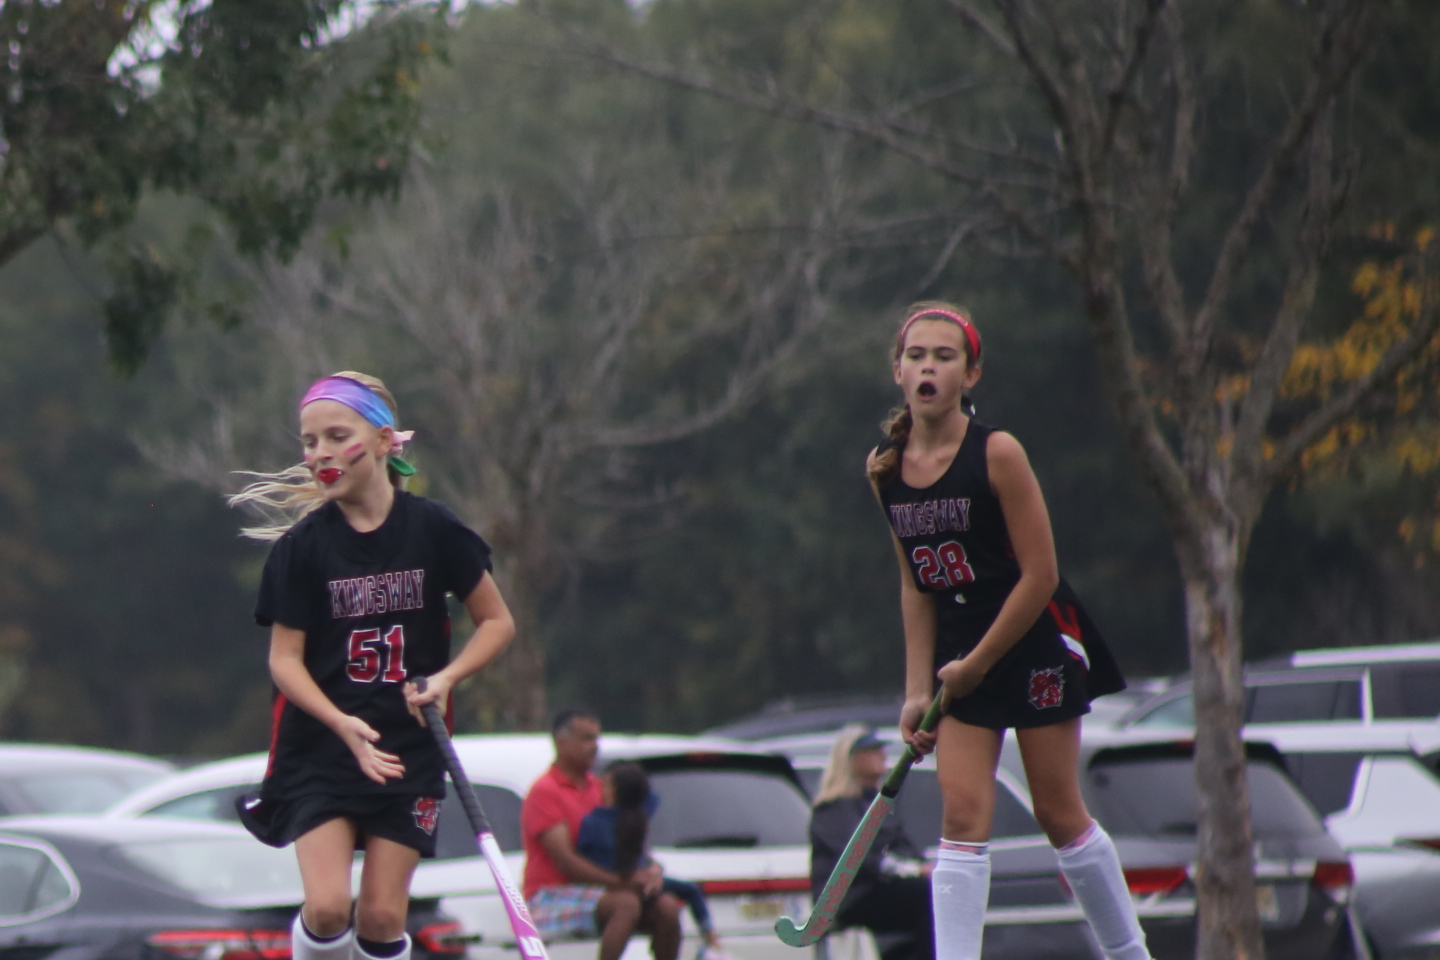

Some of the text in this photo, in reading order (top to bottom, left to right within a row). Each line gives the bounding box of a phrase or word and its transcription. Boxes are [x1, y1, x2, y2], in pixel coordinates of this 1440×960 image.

[912, 541, 975, 590] 28
[328, 569, 424, 618] KINGSWAY
[346, 625, 408, 683] 51
[808, 914, 831, 938] the
[820, 872, 853, 915] indian
